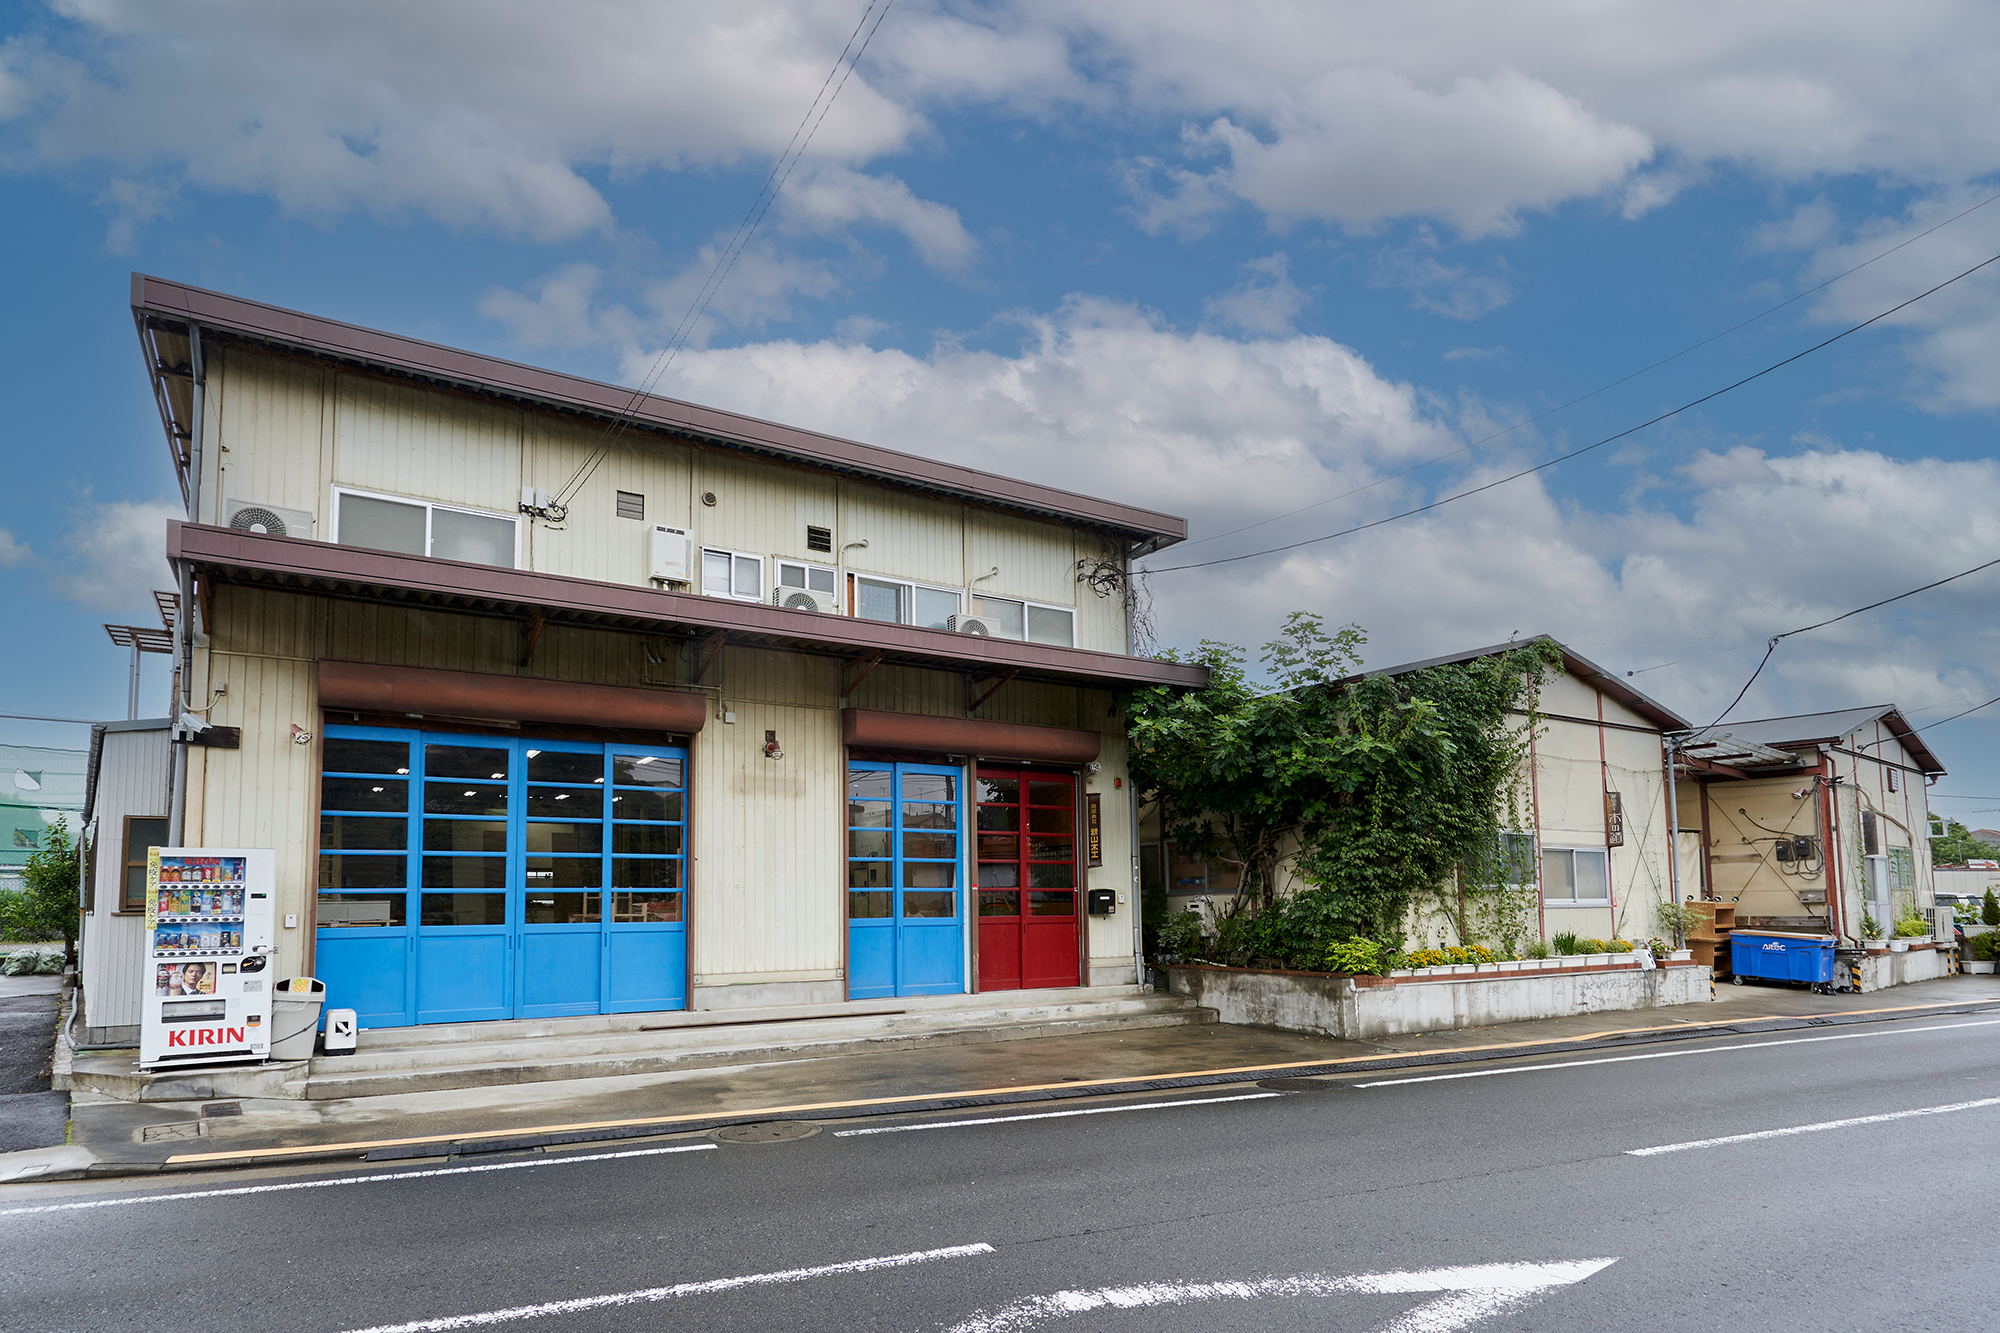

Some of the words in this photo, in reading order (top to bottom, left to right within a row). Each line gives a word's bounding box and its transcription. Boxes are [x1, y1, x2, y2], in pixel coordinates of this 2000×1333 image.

[1090, 828, 1099, 859] 秋山木工
[149, 861, 158, 888] 免疫ケア
[184, 857, 220, 866] KIRIN
[147, 899, 157, 925] 免疫ケア
[168, 1027, 244, 1047] KIRIN
